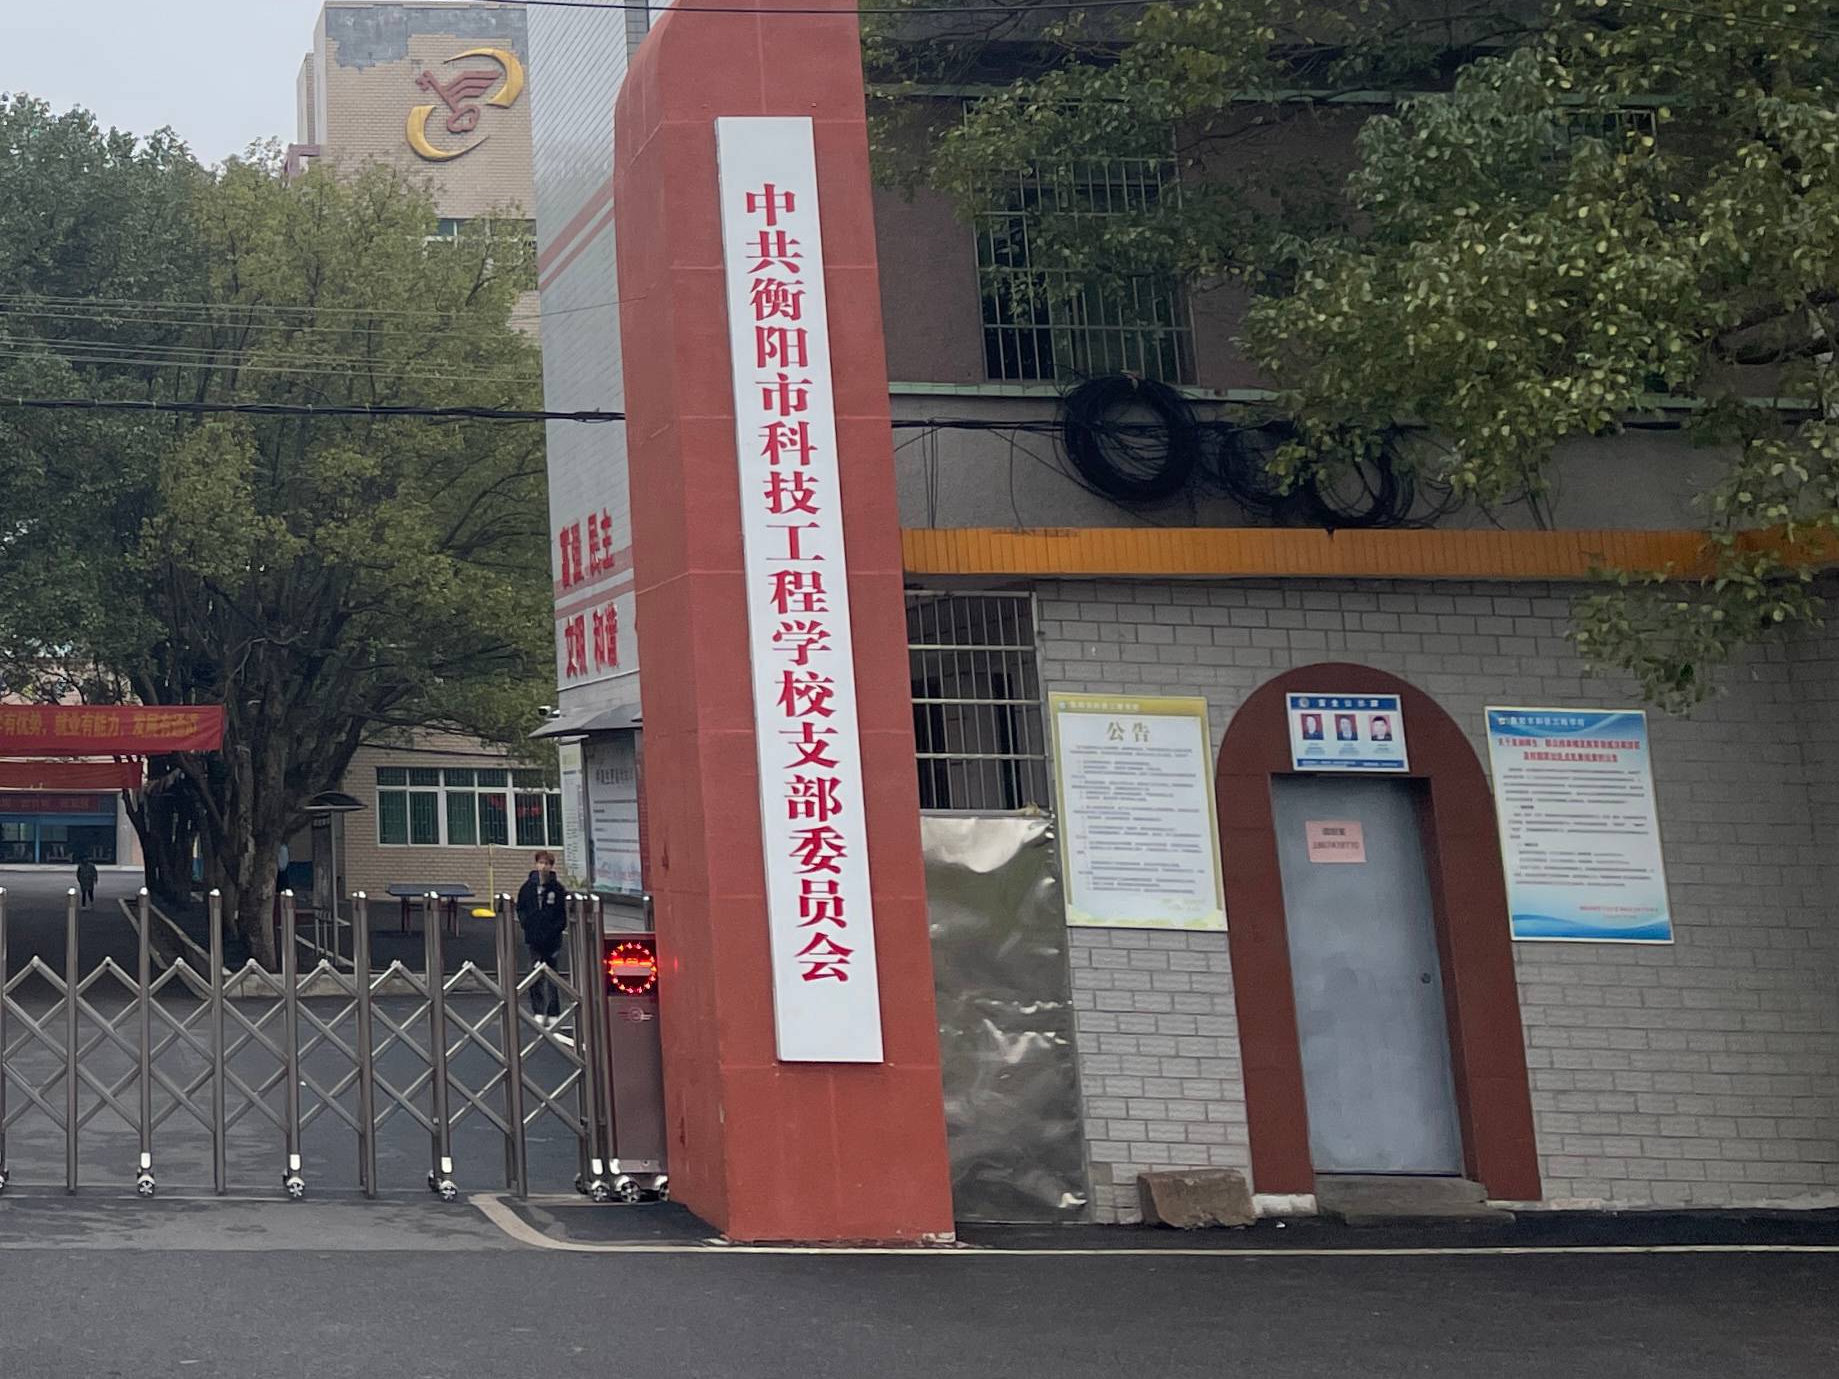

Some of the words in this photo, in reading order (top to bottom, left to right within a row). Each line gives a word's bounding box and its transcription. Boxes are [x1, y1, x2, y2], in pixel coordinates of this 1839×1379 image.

[560, 521, 585, 590] 富强
[587, 507, 616, 579] 民主
[743, 182, 856, 984] 中共衡阳市科技工程学校支部委员会
[564, 614, 588, 680] 文明
[593, 602, 621, 680] 和谐
[1106, 720, 1151, 743] 公告
